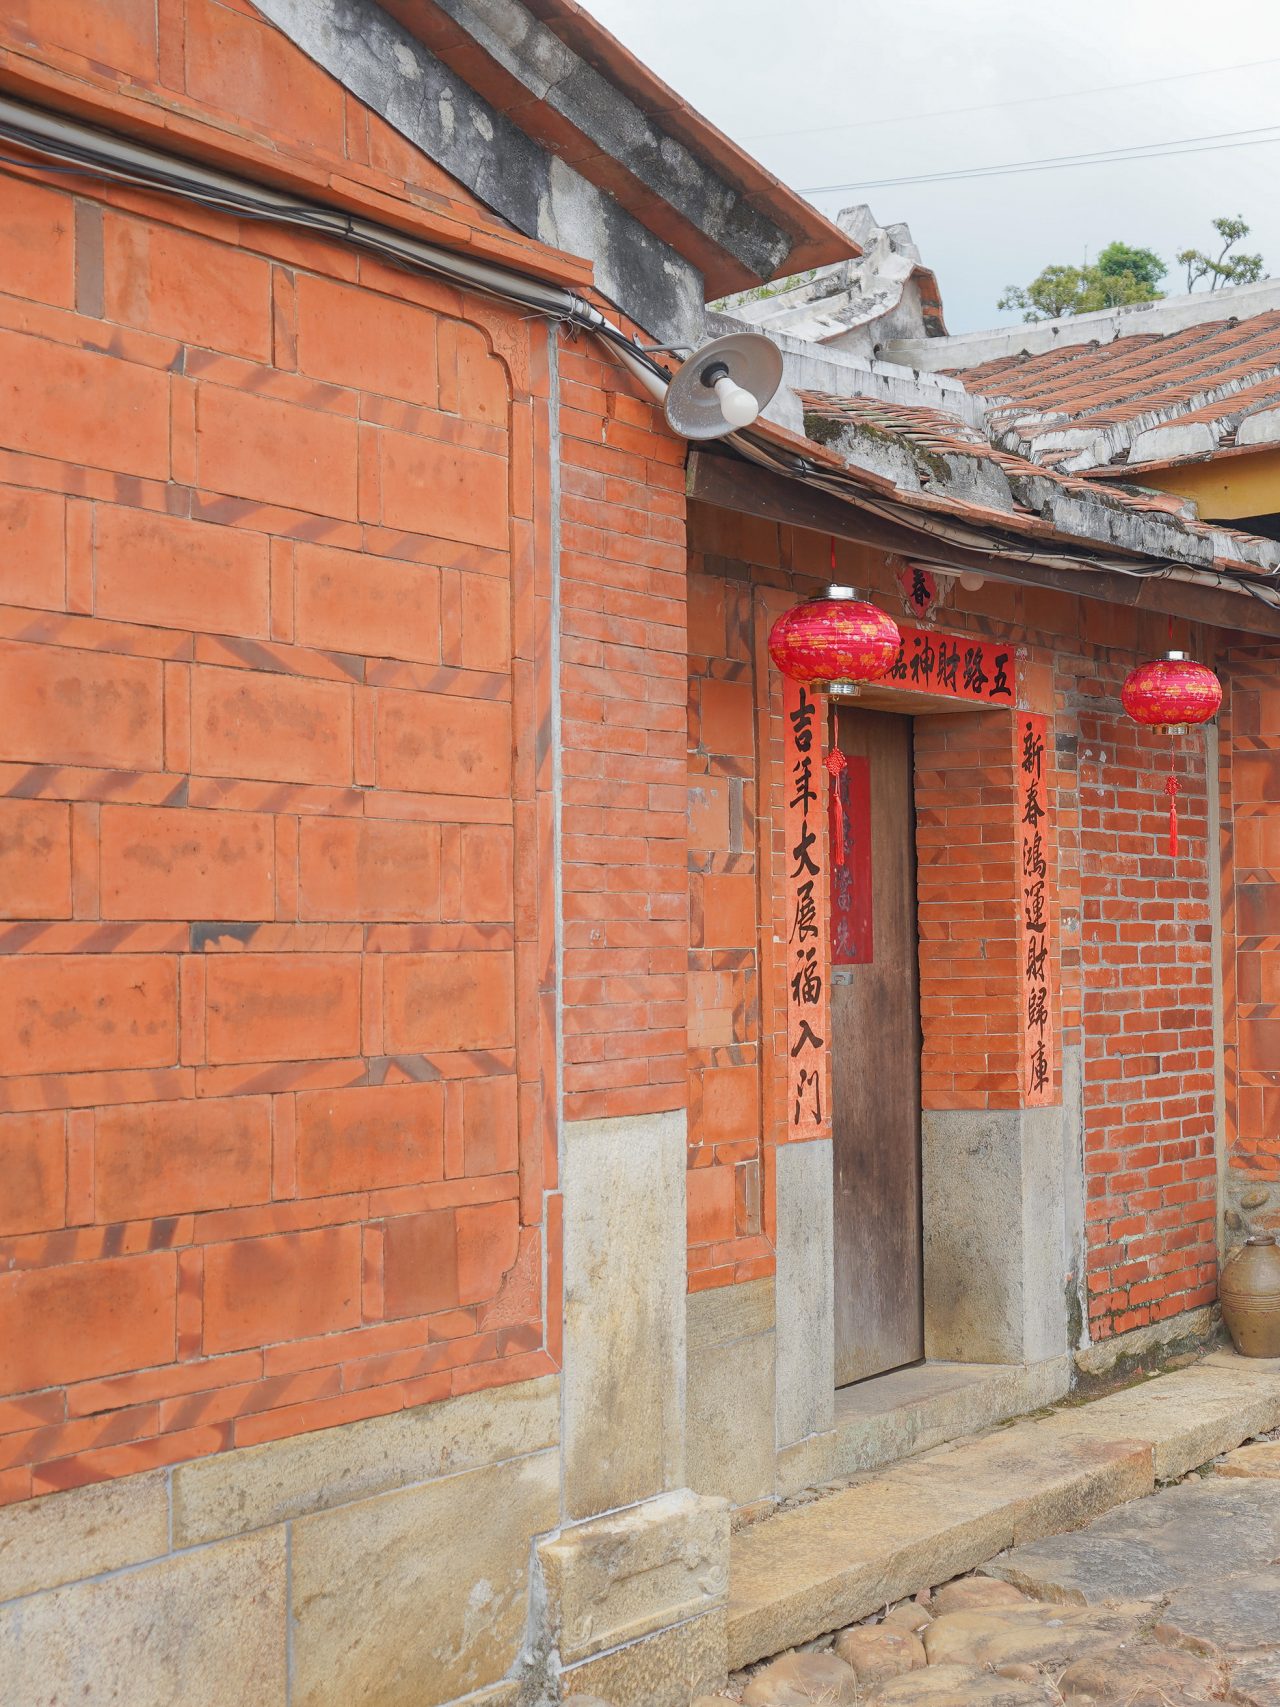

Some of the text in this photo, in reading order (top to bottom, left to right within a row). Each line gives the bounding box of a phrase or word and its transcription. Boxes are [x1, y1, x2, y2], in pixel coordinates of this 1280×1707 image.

[910, 569, 930, 607] 春
[1022, 721, 1049, 1095] 新春鴻運財歸庫
